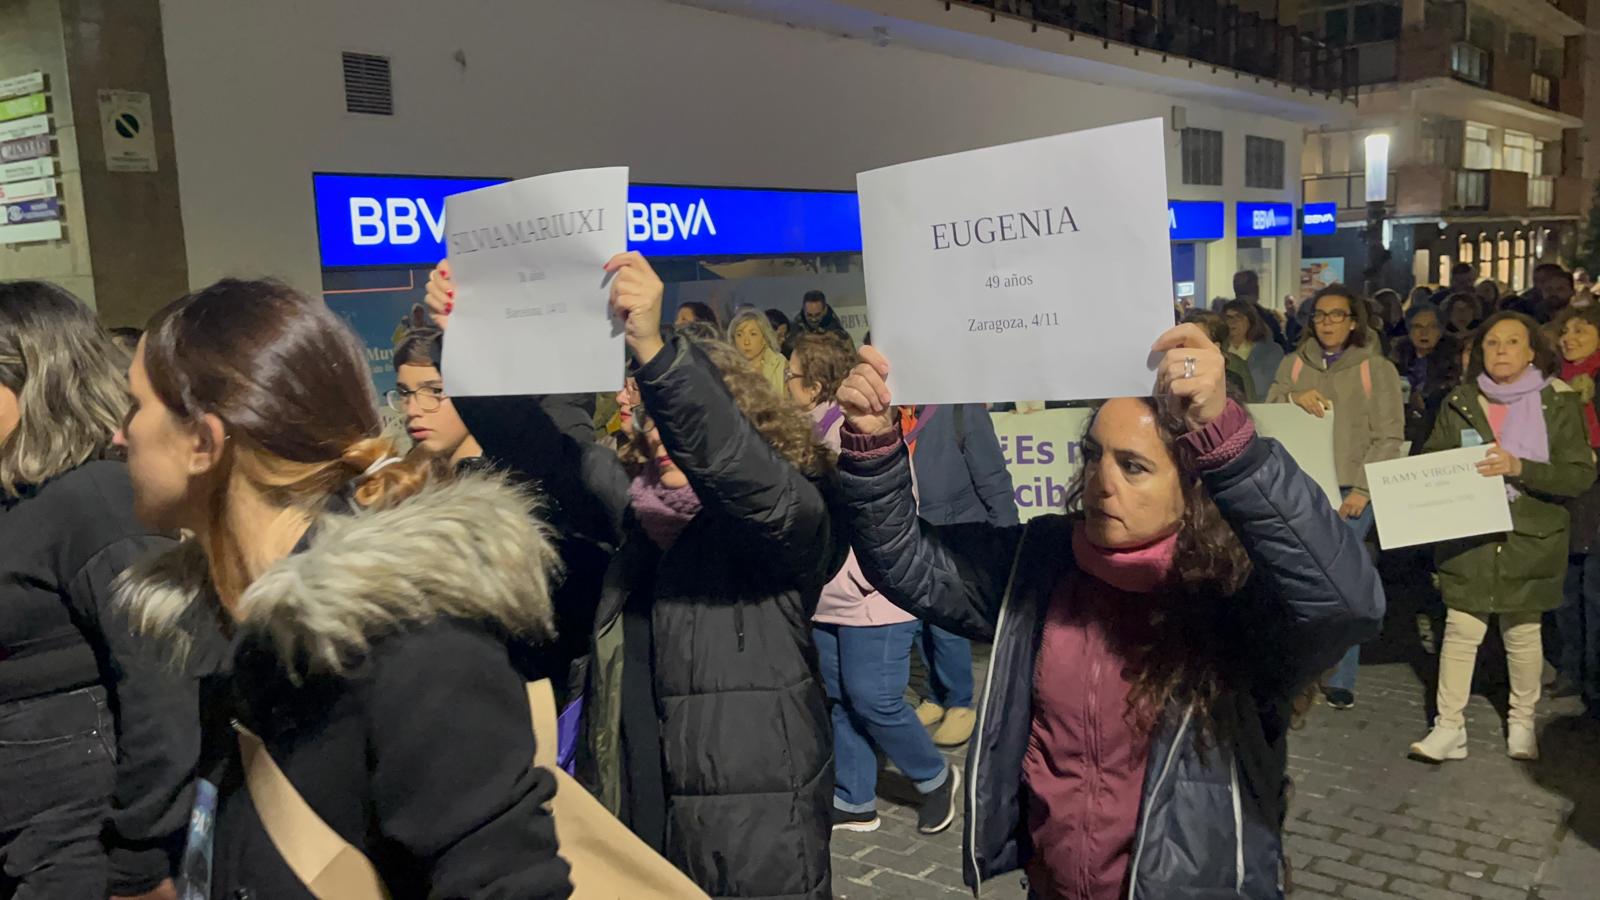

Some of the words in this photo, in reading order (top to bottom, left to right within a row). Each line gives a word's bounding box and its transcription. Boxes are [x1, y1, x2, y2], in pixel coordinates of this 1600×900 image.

[350, 197, 445, 245] BBV
[452, 224, 508, 255] SILVIA
[507, 207, 606, 246] MARIUXI
[628, 198, 716, 242] BBVA
[931, 204, 1080, 251] EUGENIA
[1304, 213, 1334, 225] BBVA
[985, 273, 1000, 290] 49
[1003, 271, 1033, 289] años
[967, 316, 1028, 334] Zaragoza,
[1031, 311, 1060, 329] 4/11
[1381, 470, 1419, 486] RAMY
[1421, 463, 1473, 479] VIRGINI
[1014, 476, 1067, 508] cib
